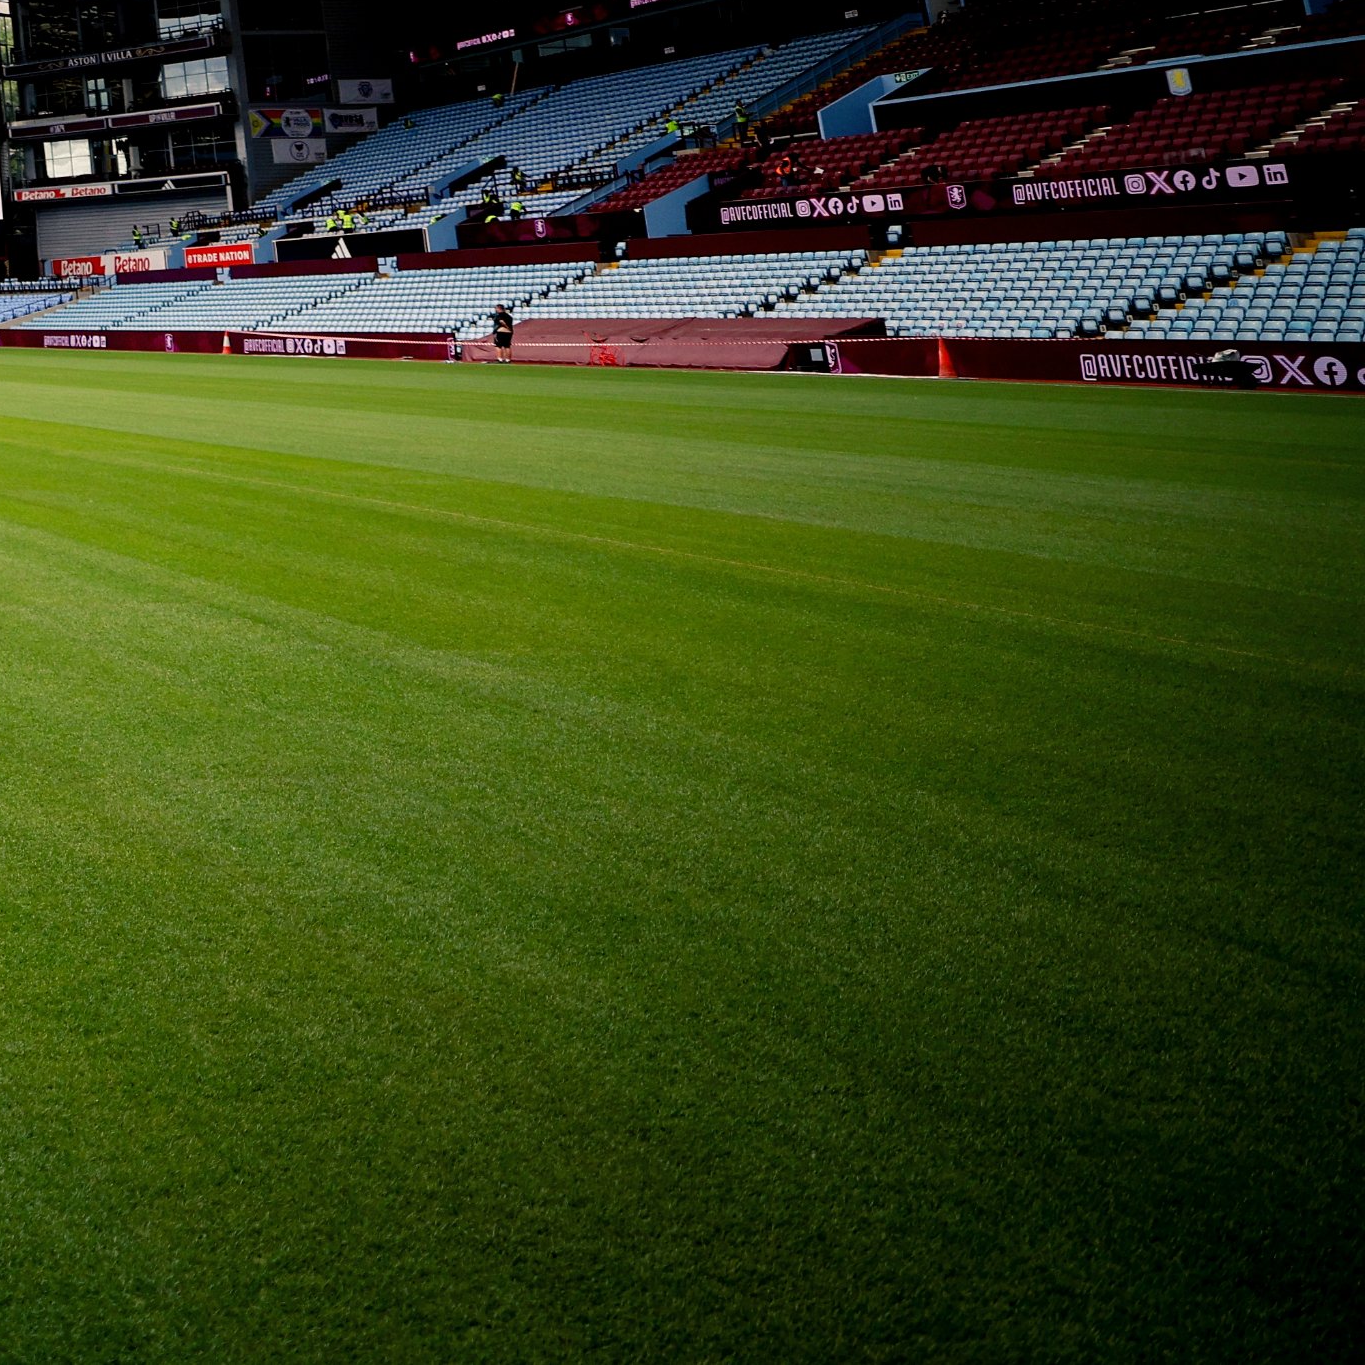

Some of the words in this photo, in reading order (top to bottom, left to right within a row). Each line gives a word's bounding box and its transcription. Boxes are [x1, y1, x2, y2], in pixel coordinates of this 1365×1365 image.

[68, 56, 97, 66] ASTON
[107, 50, 133, 61] VILLA
[21, 190, 56, 200] Betano
[71, 186, 106, 197] Betano
[1012, 177, 1120, 204] @AVFCOFFICIAL
[720, 202, 794, 225] @AVFCOFFICIAL
[192, 253, 218, 263] TRADE
[219, 250, 250, 261] NATION
[60, 261, 93, 276] Betano
[114, 256, 151, 272] Betano
